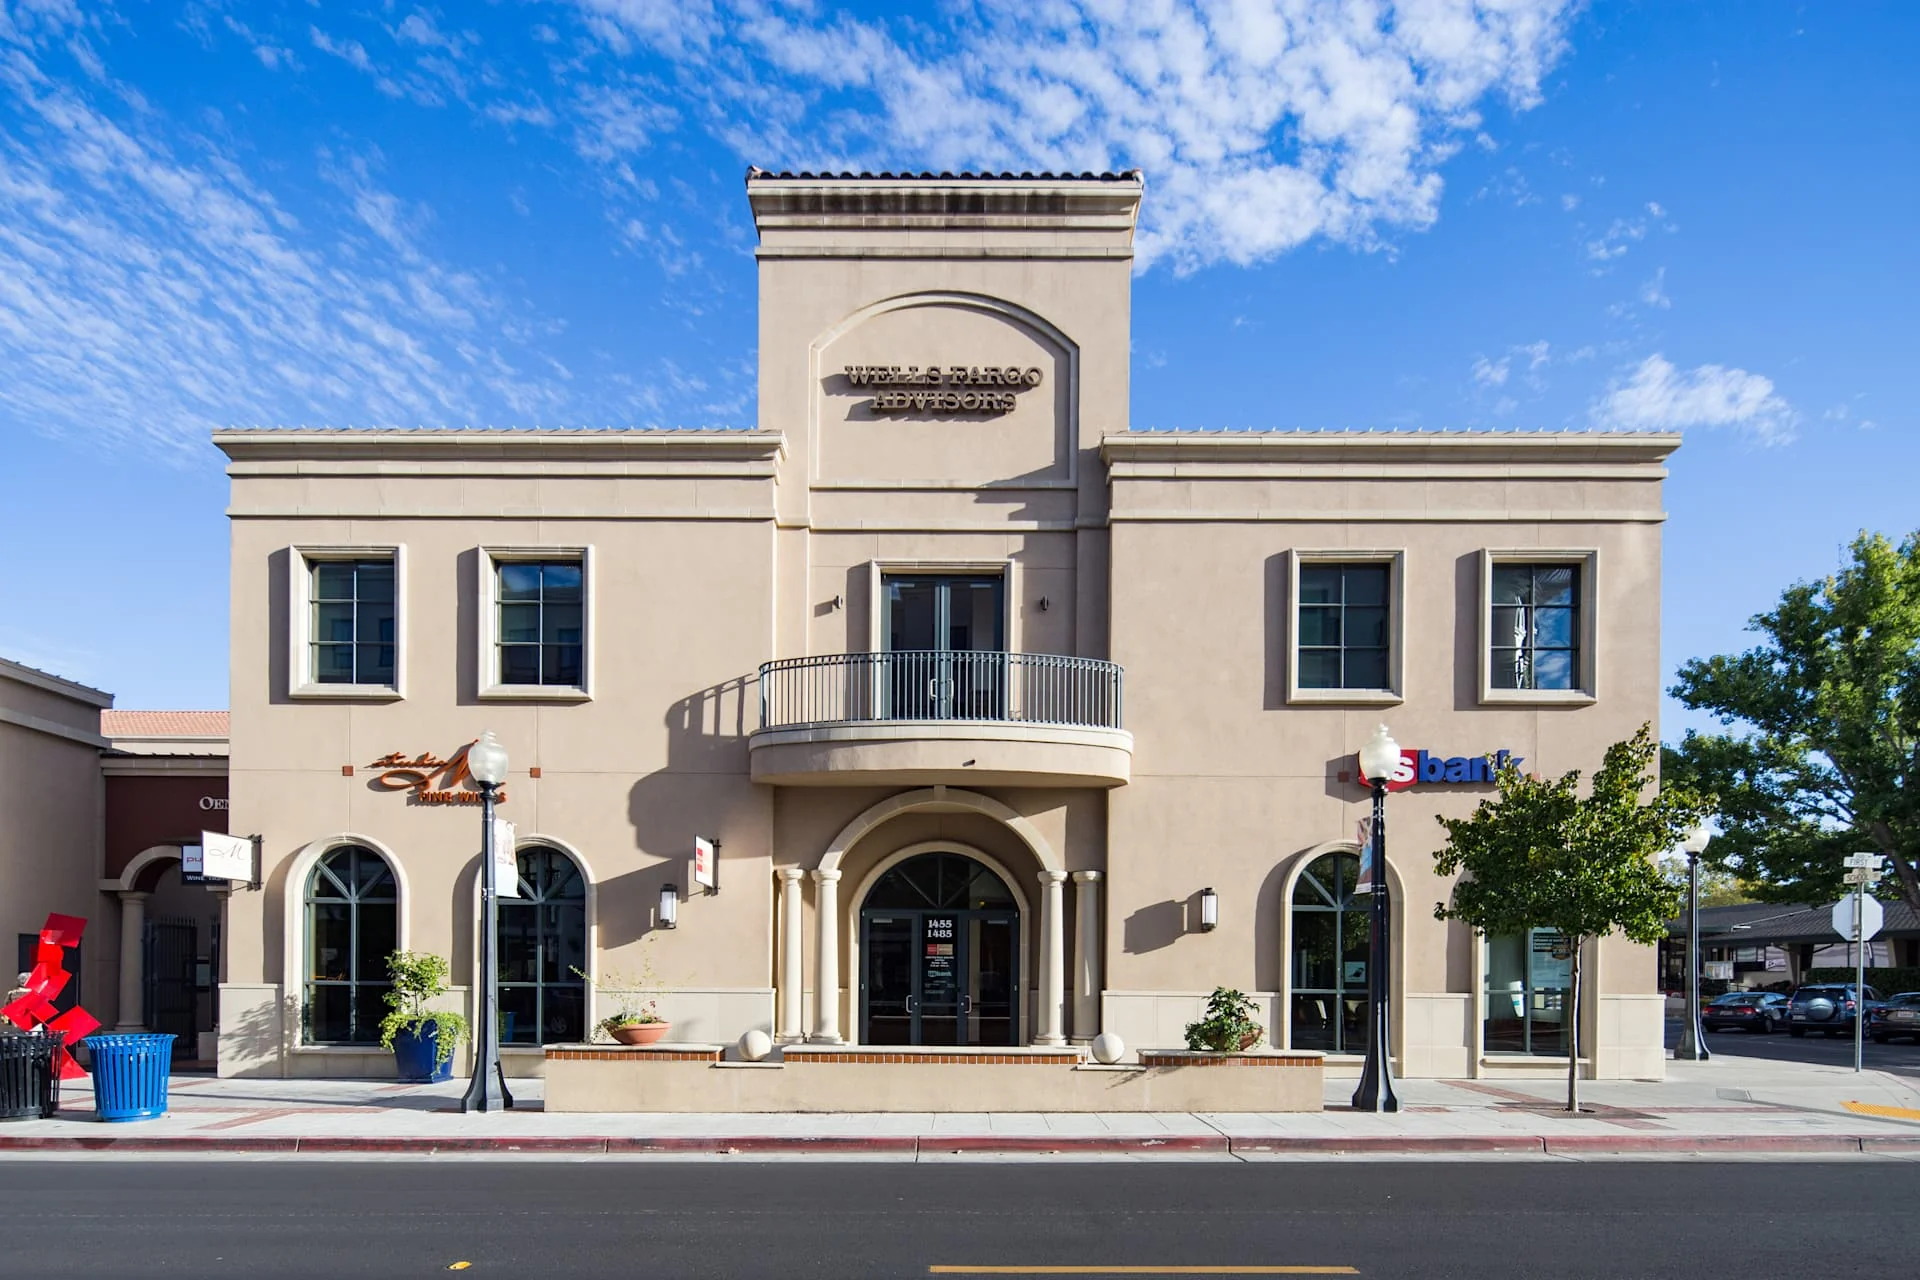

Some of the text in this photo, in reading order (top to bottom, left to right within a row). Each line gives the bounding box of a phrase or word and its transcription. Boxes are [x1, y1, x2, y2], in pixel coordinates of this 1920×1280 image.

[844, 366, 1044, 387] WELLS FARGO
[870, 391, 1017, 412] ADVISORS
[418, 791, 453, 802] FINE
[927, 920, 953, 929] 1455
[927, 930, 953, 938] 1485
